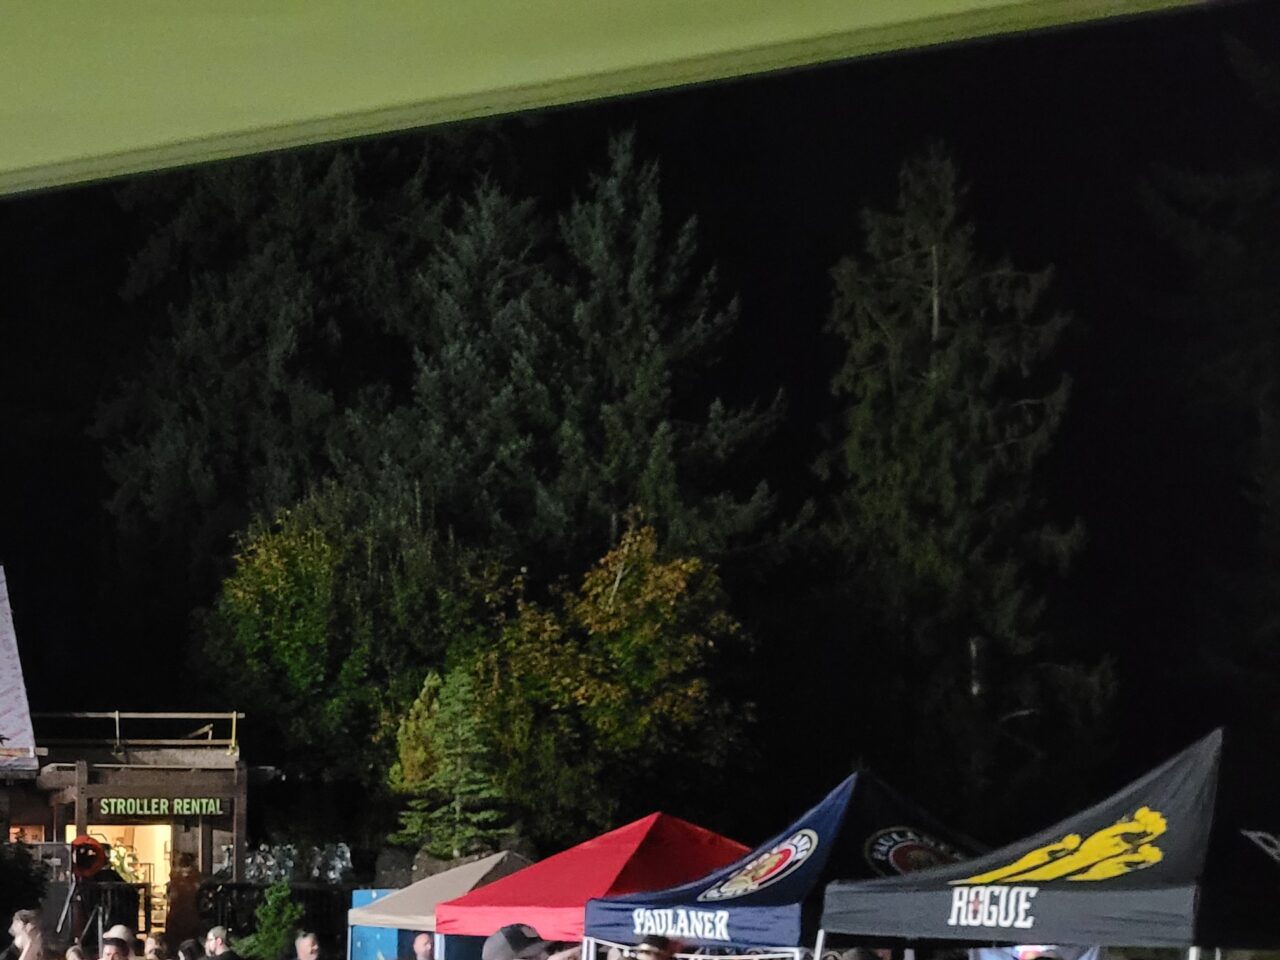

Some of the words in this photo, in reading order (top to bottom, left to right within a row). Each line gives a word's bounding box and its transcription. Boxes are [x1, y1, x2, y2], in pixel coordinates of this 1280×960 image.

[99, 797, 169, 815] STROLLER
[173, 797, 223, 815] RENTAL
[947, 886, 1038, 929] ROGUE
[632, 908, 730, 941] PAULANER
